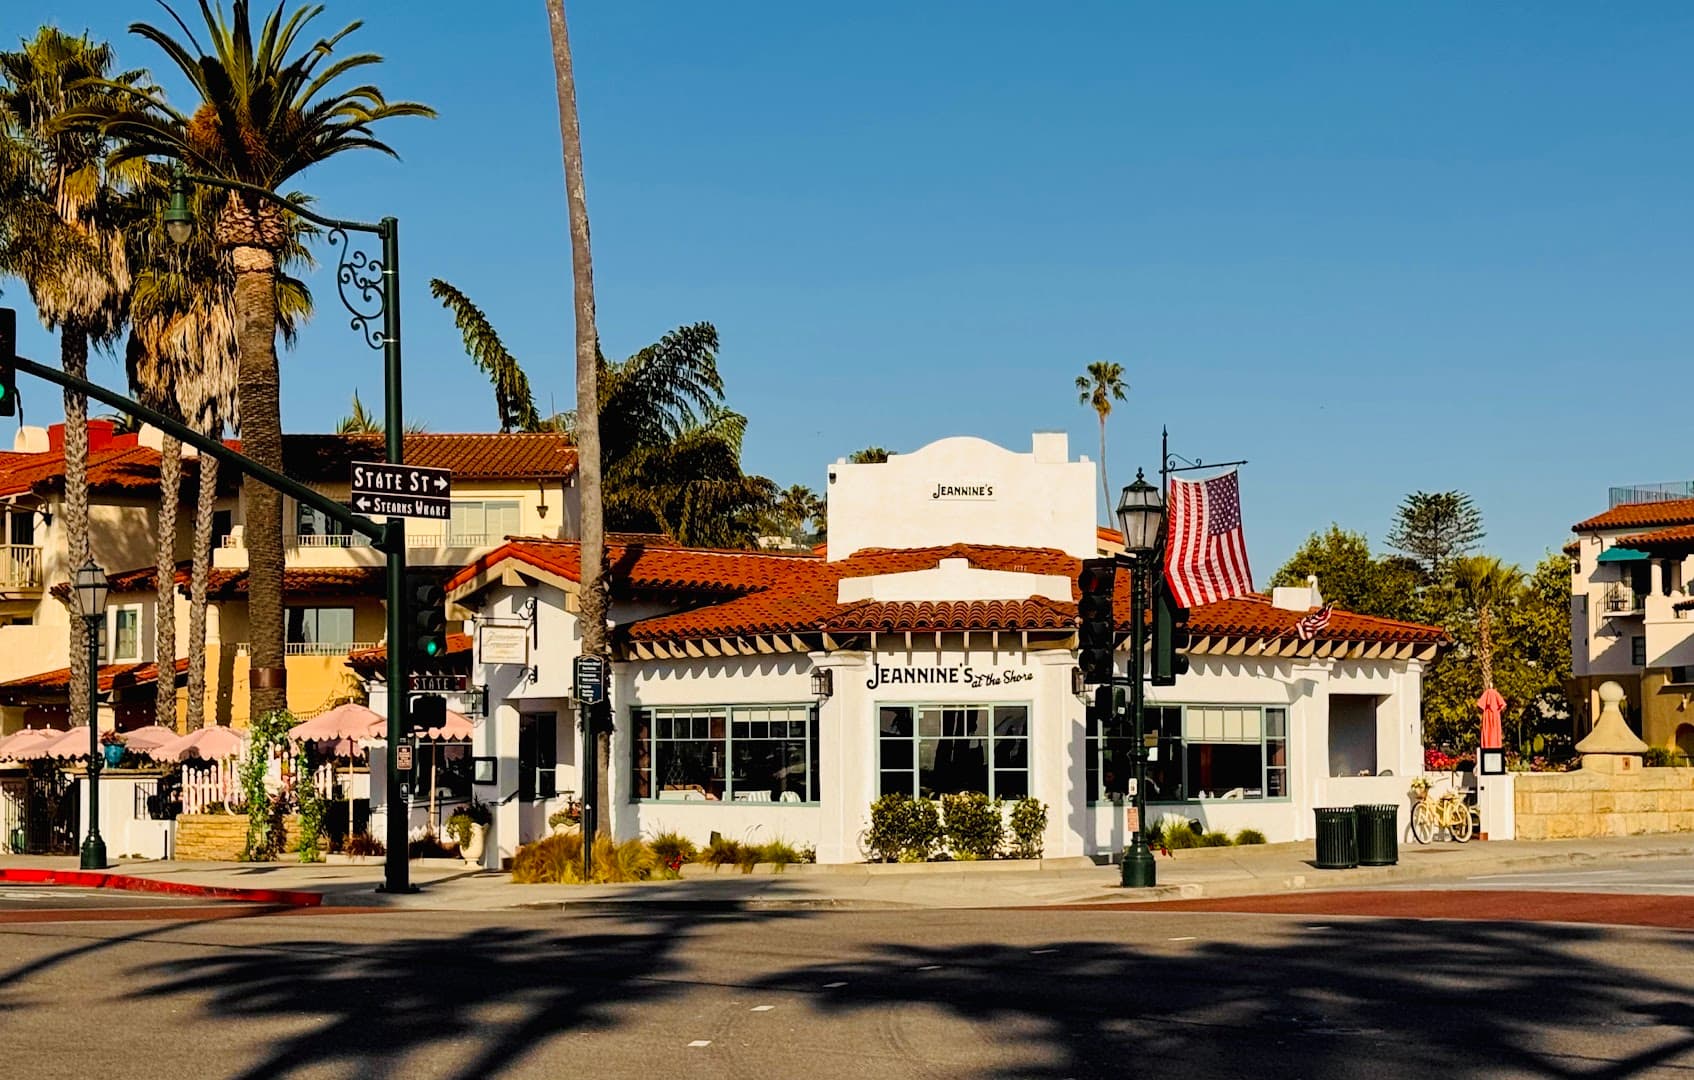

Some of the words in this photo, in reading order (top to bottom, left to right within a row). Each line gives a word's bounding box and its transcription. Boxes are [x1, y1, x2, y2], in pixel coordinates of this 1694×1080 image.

[354, 467, 402, 490] STATE
[410, 471, 430, 492] ST
[932, 483, 993, 499] JEANNINE'S
[374, 497, 412, 514] STEARNS
[415, 500, 447, 517] WHARF
[413, 677, 449, 690] STATE
[866, 662, 973, 690] JEANNINE'S
[971, 674, 987, 688] at
[985, 672, 1001, 686] the
[1003, 669, 1034, 684] Shore
